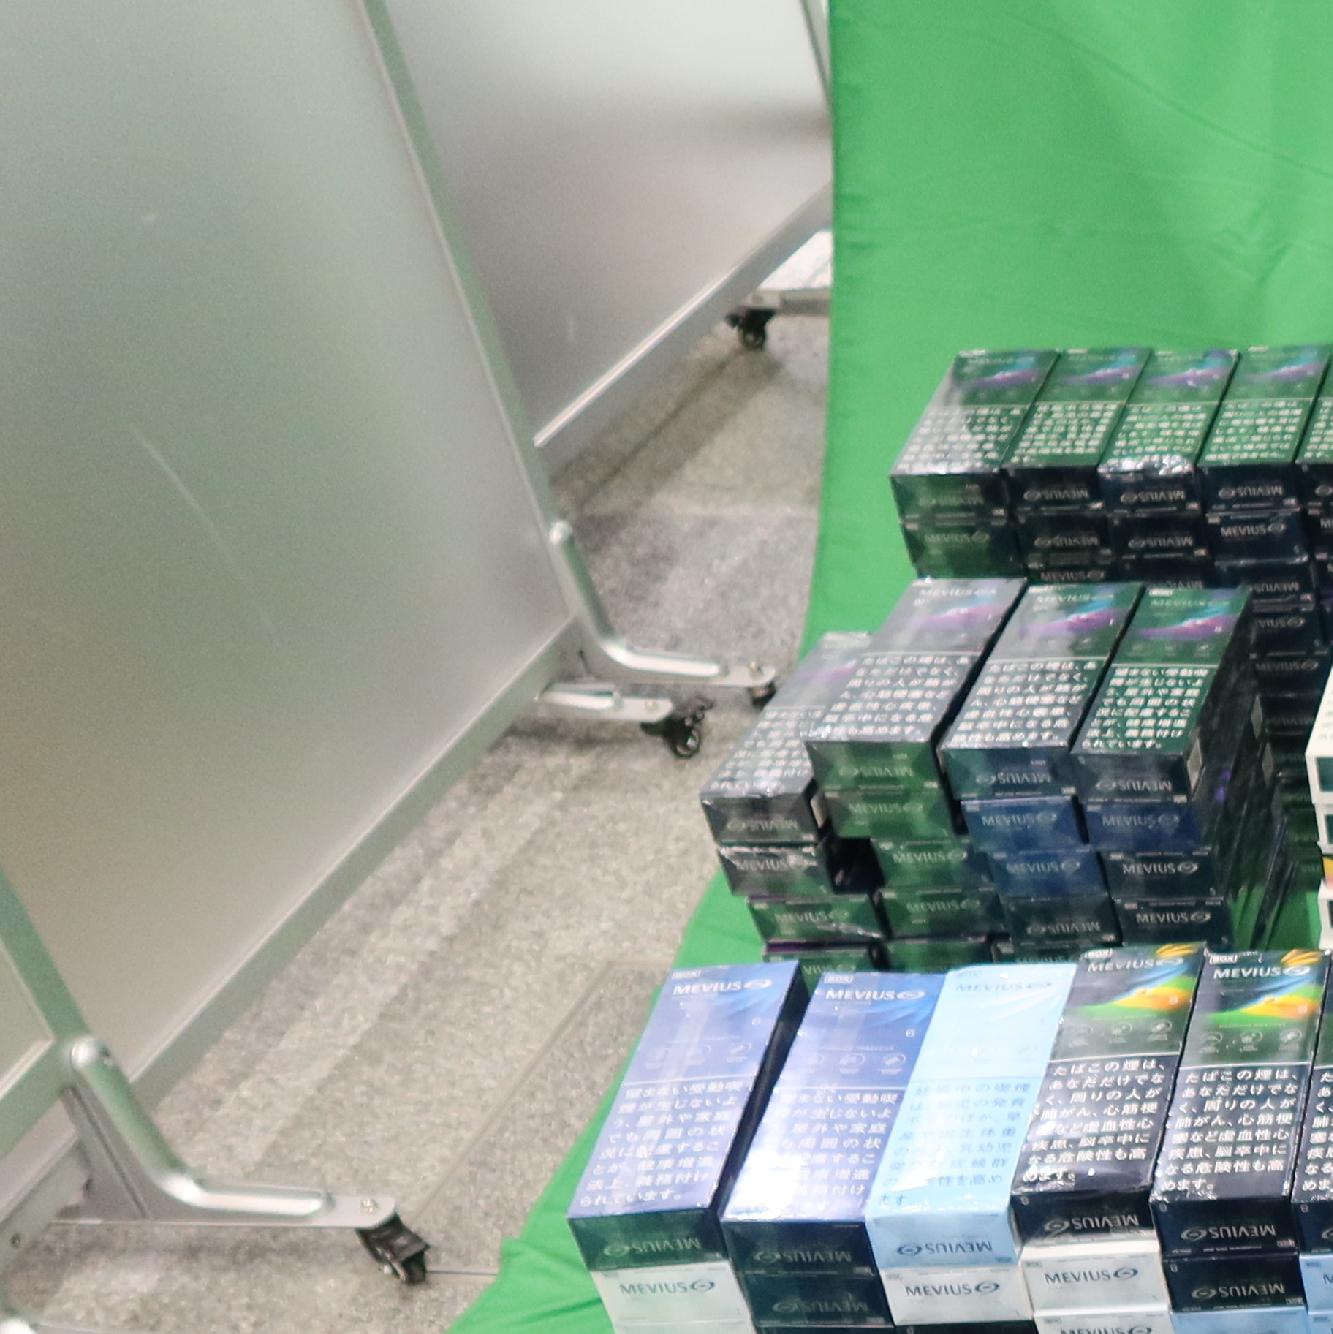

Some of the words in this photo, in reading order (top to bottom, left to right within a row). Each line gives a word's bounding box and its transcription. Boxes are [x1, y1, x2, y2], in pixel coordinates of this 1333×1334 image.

[982, 813, 1035, 827] MEVIUS
[1124, 862, 1176, 874] MEVIUS
[1214, 968, 1282, 978] MEVIUS
[673, 981, 743, 995] MEVIUS
[826, 989, 895, 1001] MEVIUS
[1073, 1214, 1139, 1230] MEVIUS
[1211, 1224, 1277, 1238] MEVIUS
[925, 1240, 992, 1253] MEVIUS
[781, 1251, 850, 1262] MEVIUS
[1045, 1269, 1111, 1285] MEVIUS
[620, 1282, 687, 1295] MEVIUS
[905, 1283, 971, 1296] MEVIUS
